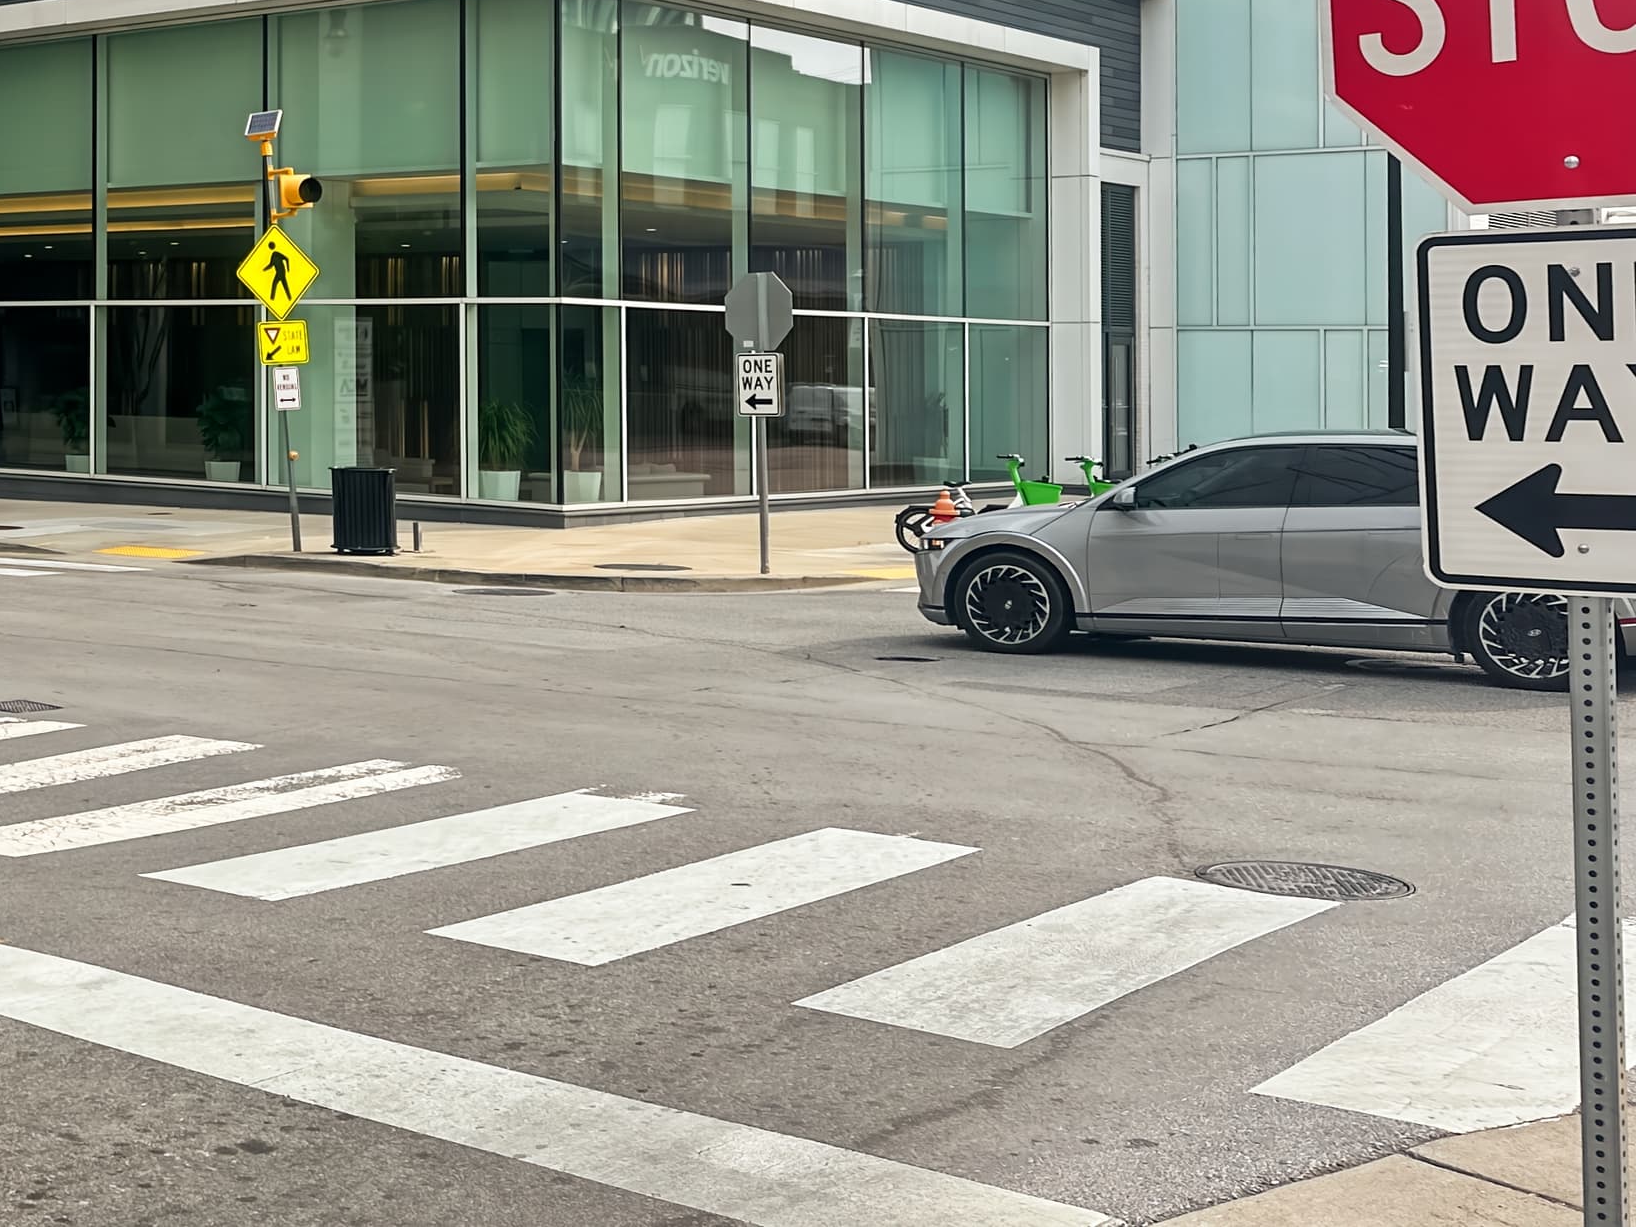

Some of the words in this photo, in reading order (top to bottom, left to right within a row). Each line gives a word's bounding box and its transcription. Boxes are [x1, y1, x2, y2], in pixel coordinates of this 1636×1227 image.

[1462, 261, 1636, 345] ON
[282, 329, 303, 341] STATE
[286, 346, 301, 356] LAW
[742, 358, 773, 374] ONE
[741, 375, 774, 391] WAY
